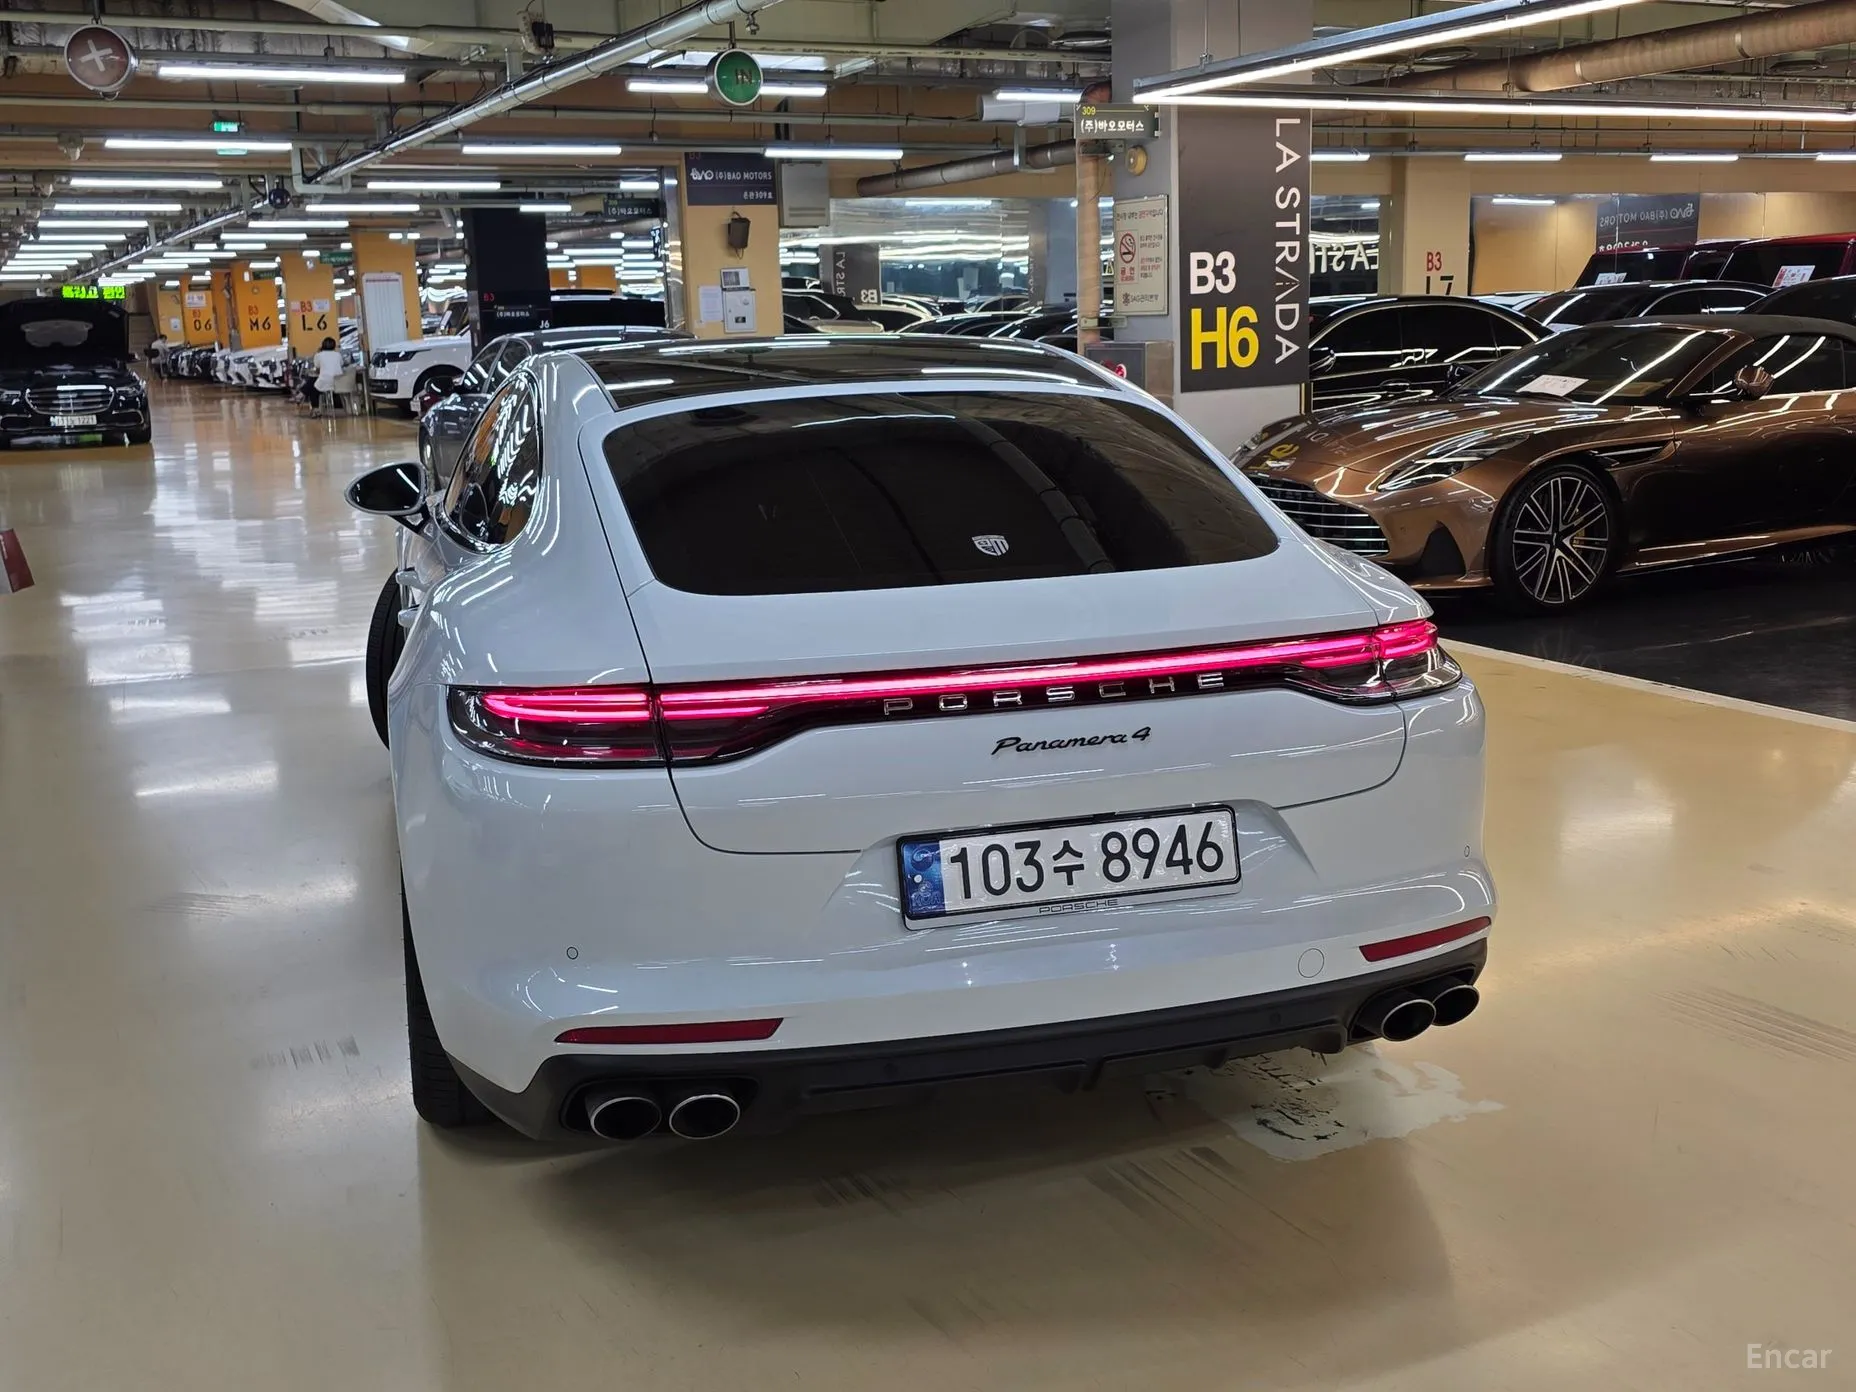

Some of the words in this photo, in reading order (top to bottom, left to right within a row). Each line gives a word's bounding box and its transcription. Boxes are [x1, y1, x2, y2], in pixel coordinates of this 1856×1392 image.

[734, 68, 753, 85] IN
[1082, 106, 1096, 116] 309
[1080, 119, 1145, 133] (주)바오모터스
[1275, 118, 1301, 173] LA
[743, 171, 772, 180] MOTORS
[1426, 251, 1442, 272] B3
[1189, 251, 1237, 295] B3
[1275, 186, 1301, 364] STRADA
[300, 300, 313, 312] B3
[249, 316, 271, 331] M6
[301, 314, 328, 331] L6
[539, 320, 550, 328] J6
[1191, 305, 1260, 370] H6
[884, 672, 1225, 716] PORSCHE
[991, 732, 1130, 755] Panamera
[1131, 726, 1152, 742] 4
[950, 840, 1085, 899] 103수
[1100, 821, 1224, 884] 8946
[1039, 899, 1119, 913] PORSCHE
